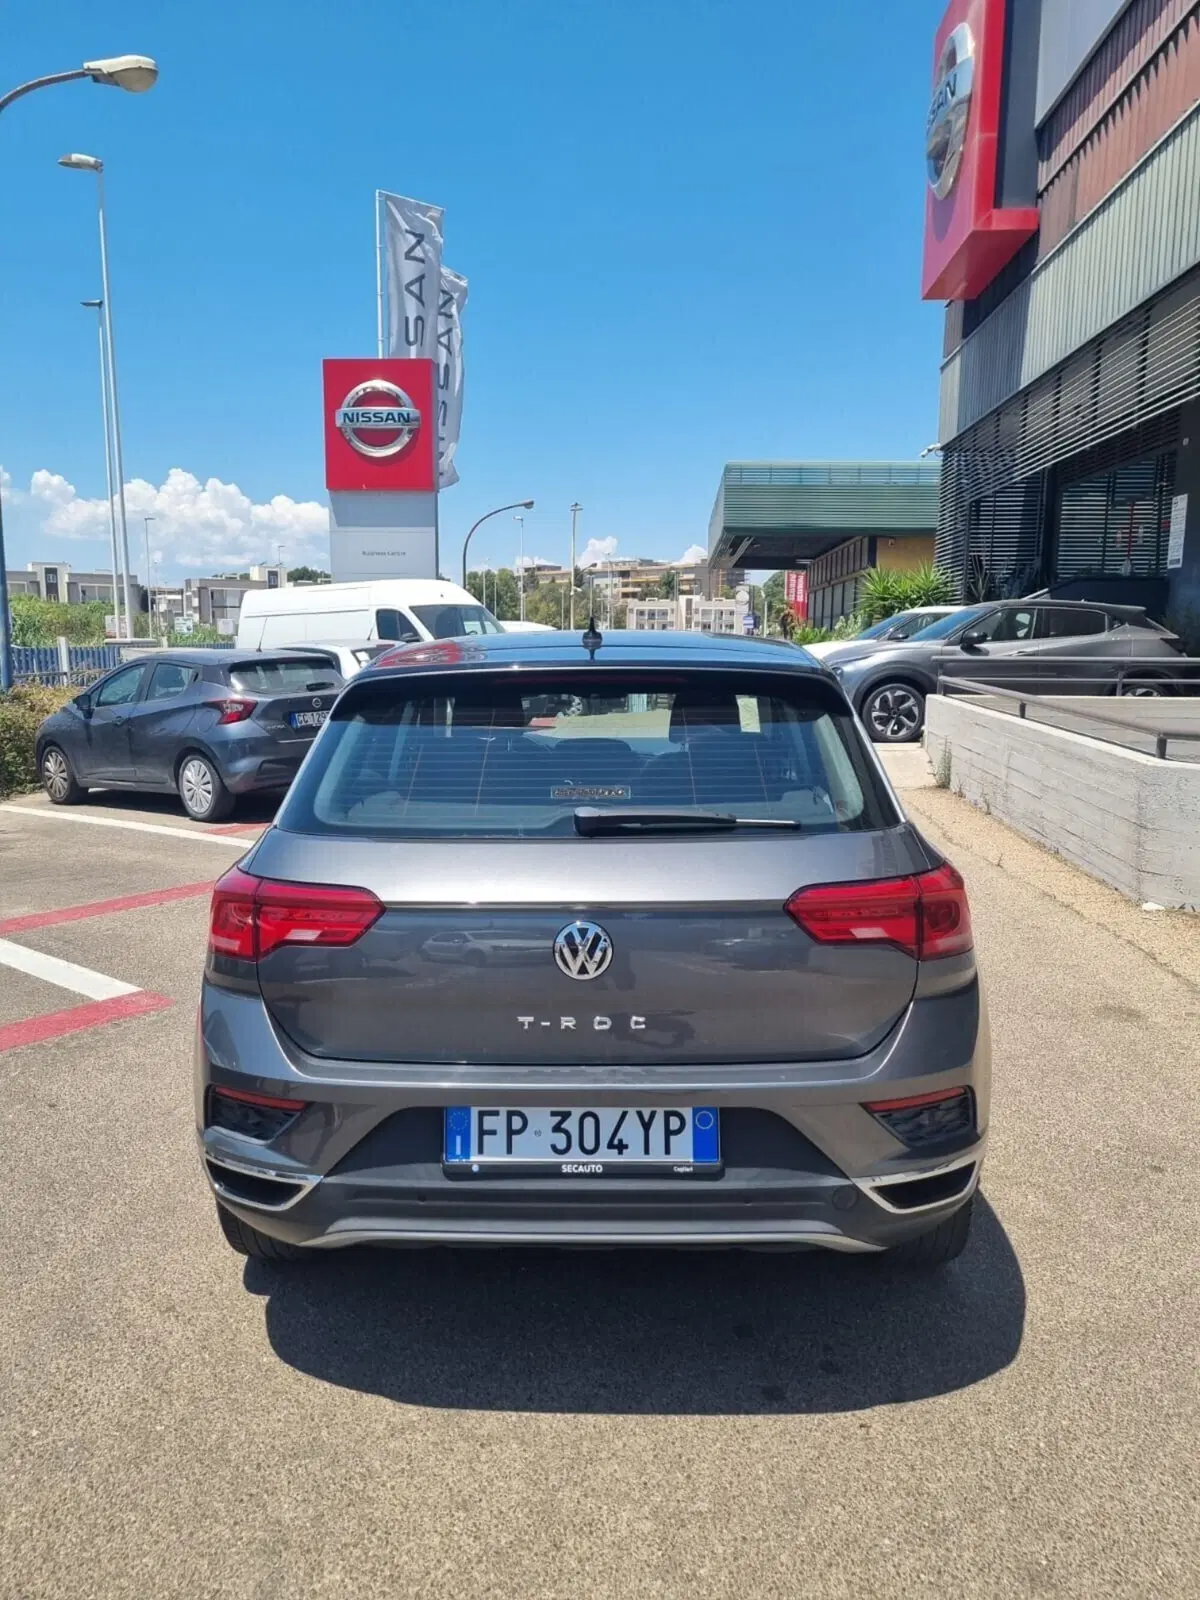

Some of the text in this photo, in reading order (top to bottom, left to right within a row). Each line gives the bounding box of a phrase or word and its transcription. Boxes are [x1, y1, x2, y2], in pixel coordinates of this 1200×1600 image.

[343, 411, 411, 424] NISSAN
[516, 1015, 646, 1031] T-ROC
[477, 1110, 529, 1155] FP
[561, 1163, 603, 1174] SECAUTO
